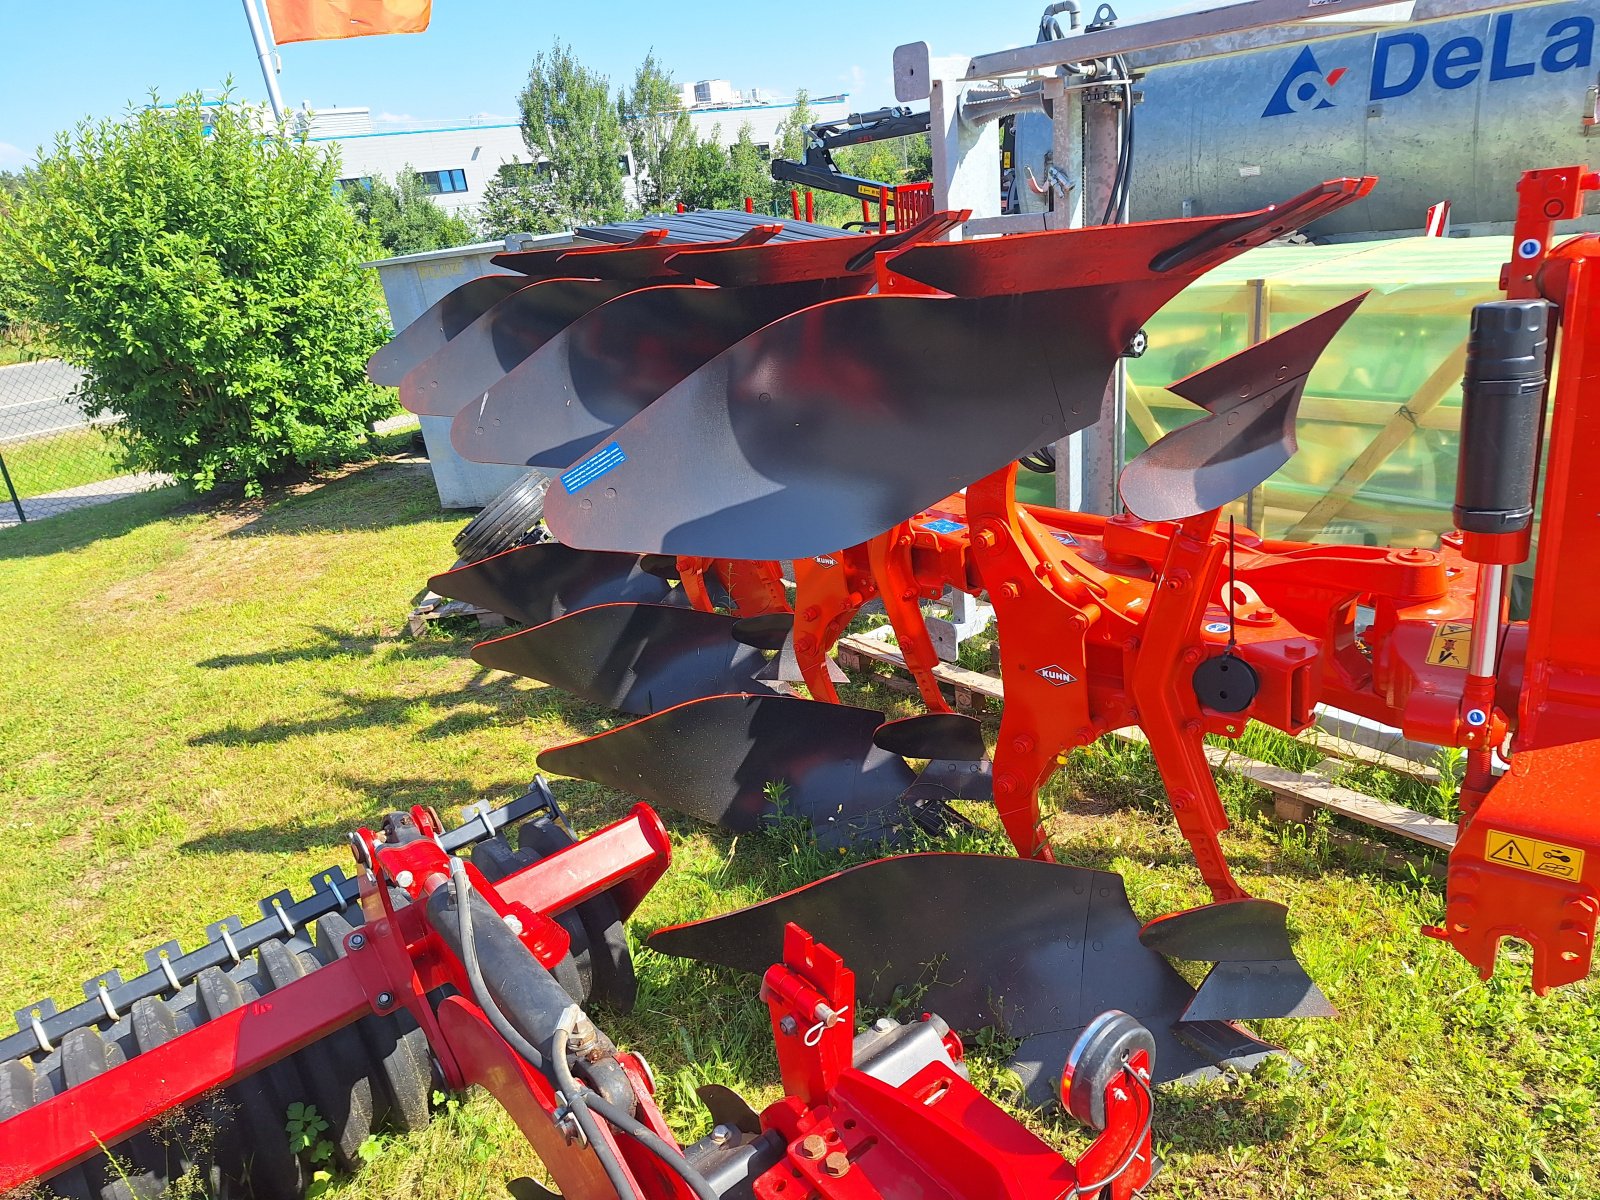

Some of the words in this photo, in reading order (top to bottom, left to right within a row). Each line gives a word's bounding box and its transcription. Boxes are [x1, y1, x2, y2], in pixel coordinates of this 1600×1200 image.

[1369, 13, 1594, 101] DeLa
[816, 557, 834, 565] KUHN
[1042, 669, 1070, 682] KUHN
